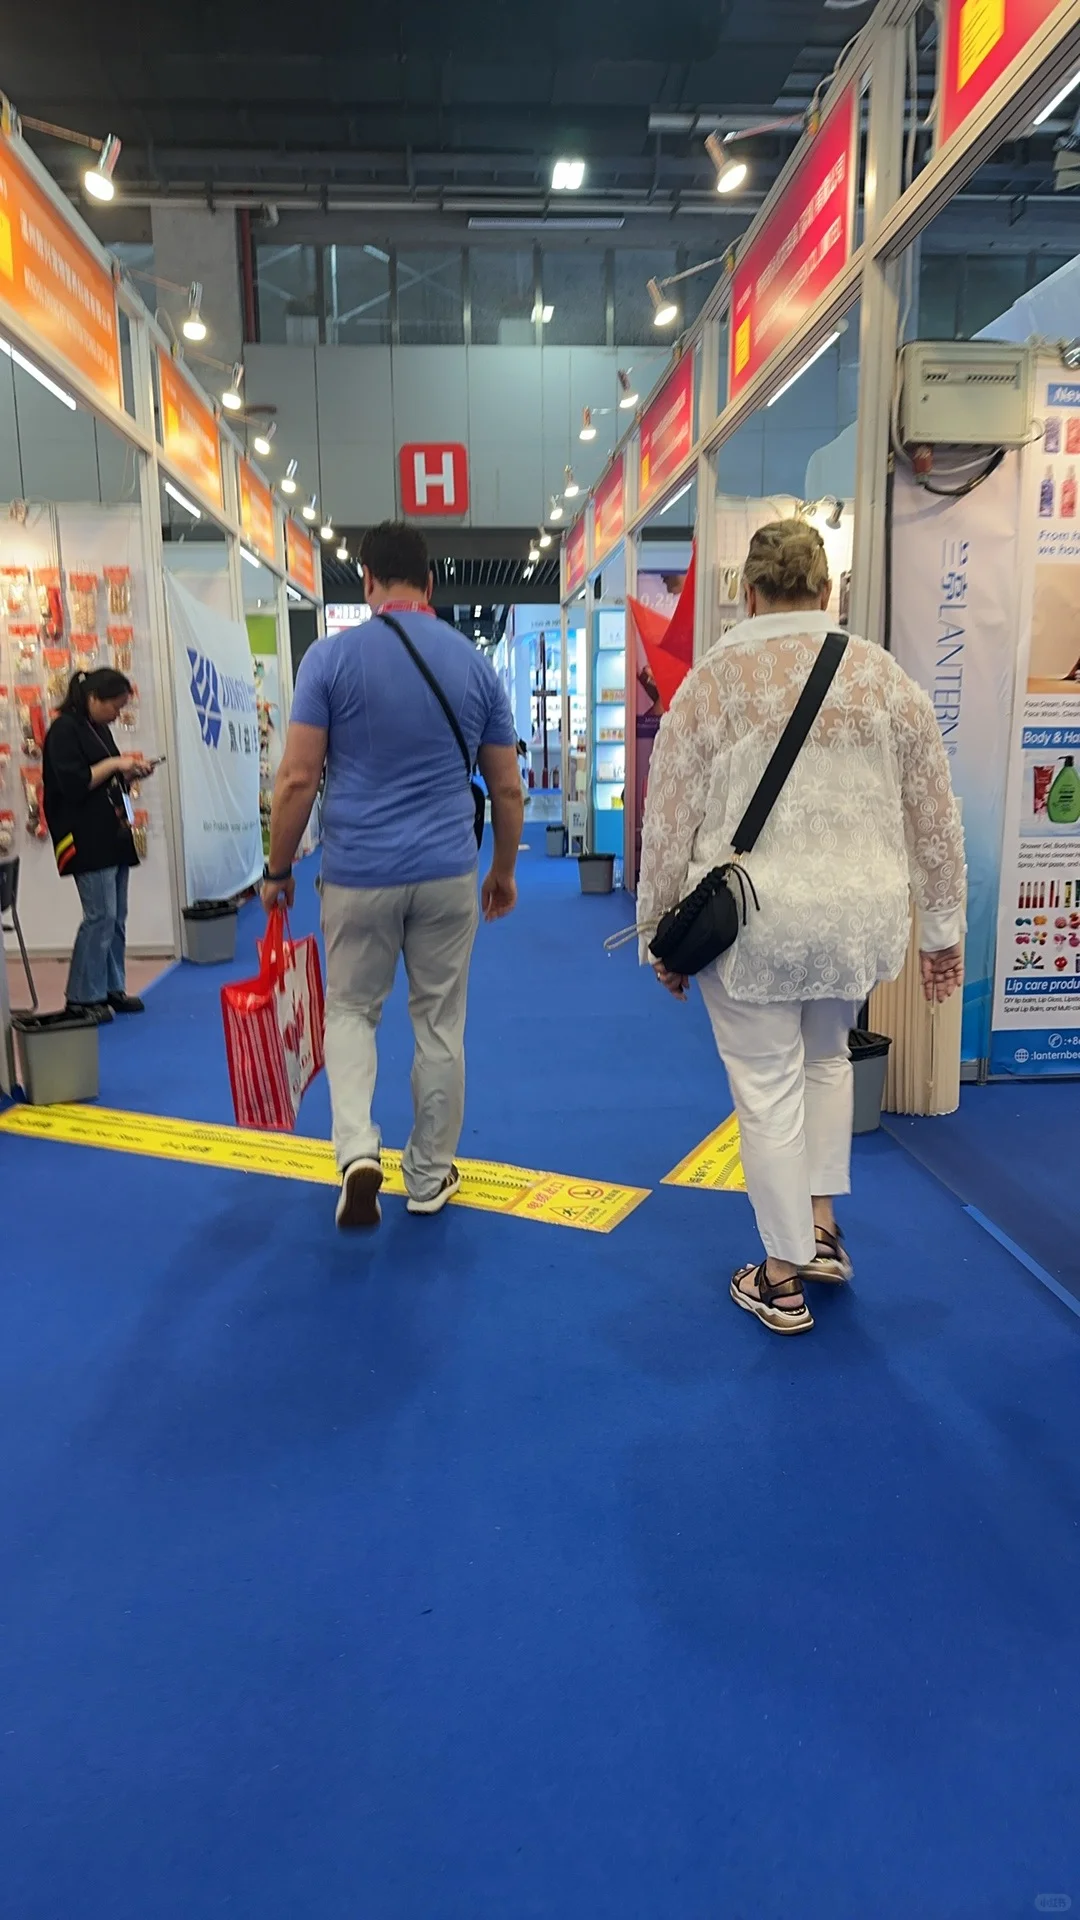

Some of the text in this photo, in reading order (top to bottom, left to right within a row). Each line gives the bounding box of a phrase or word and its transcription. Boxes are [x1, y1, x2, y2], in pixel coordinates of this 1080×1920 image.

[414, 451, 454, 506] H
[1037, 529, 1069, 541] From
[1038, 545, 1056, 555] we
[1024, 730, 1052, 746] Body
[1052, 731, 1062, 744] &
[1006, 979, 1023, 993] Lip
[1025, 981, 1048, 991] care
[1063, 1036, 1080, 1046] :+8
